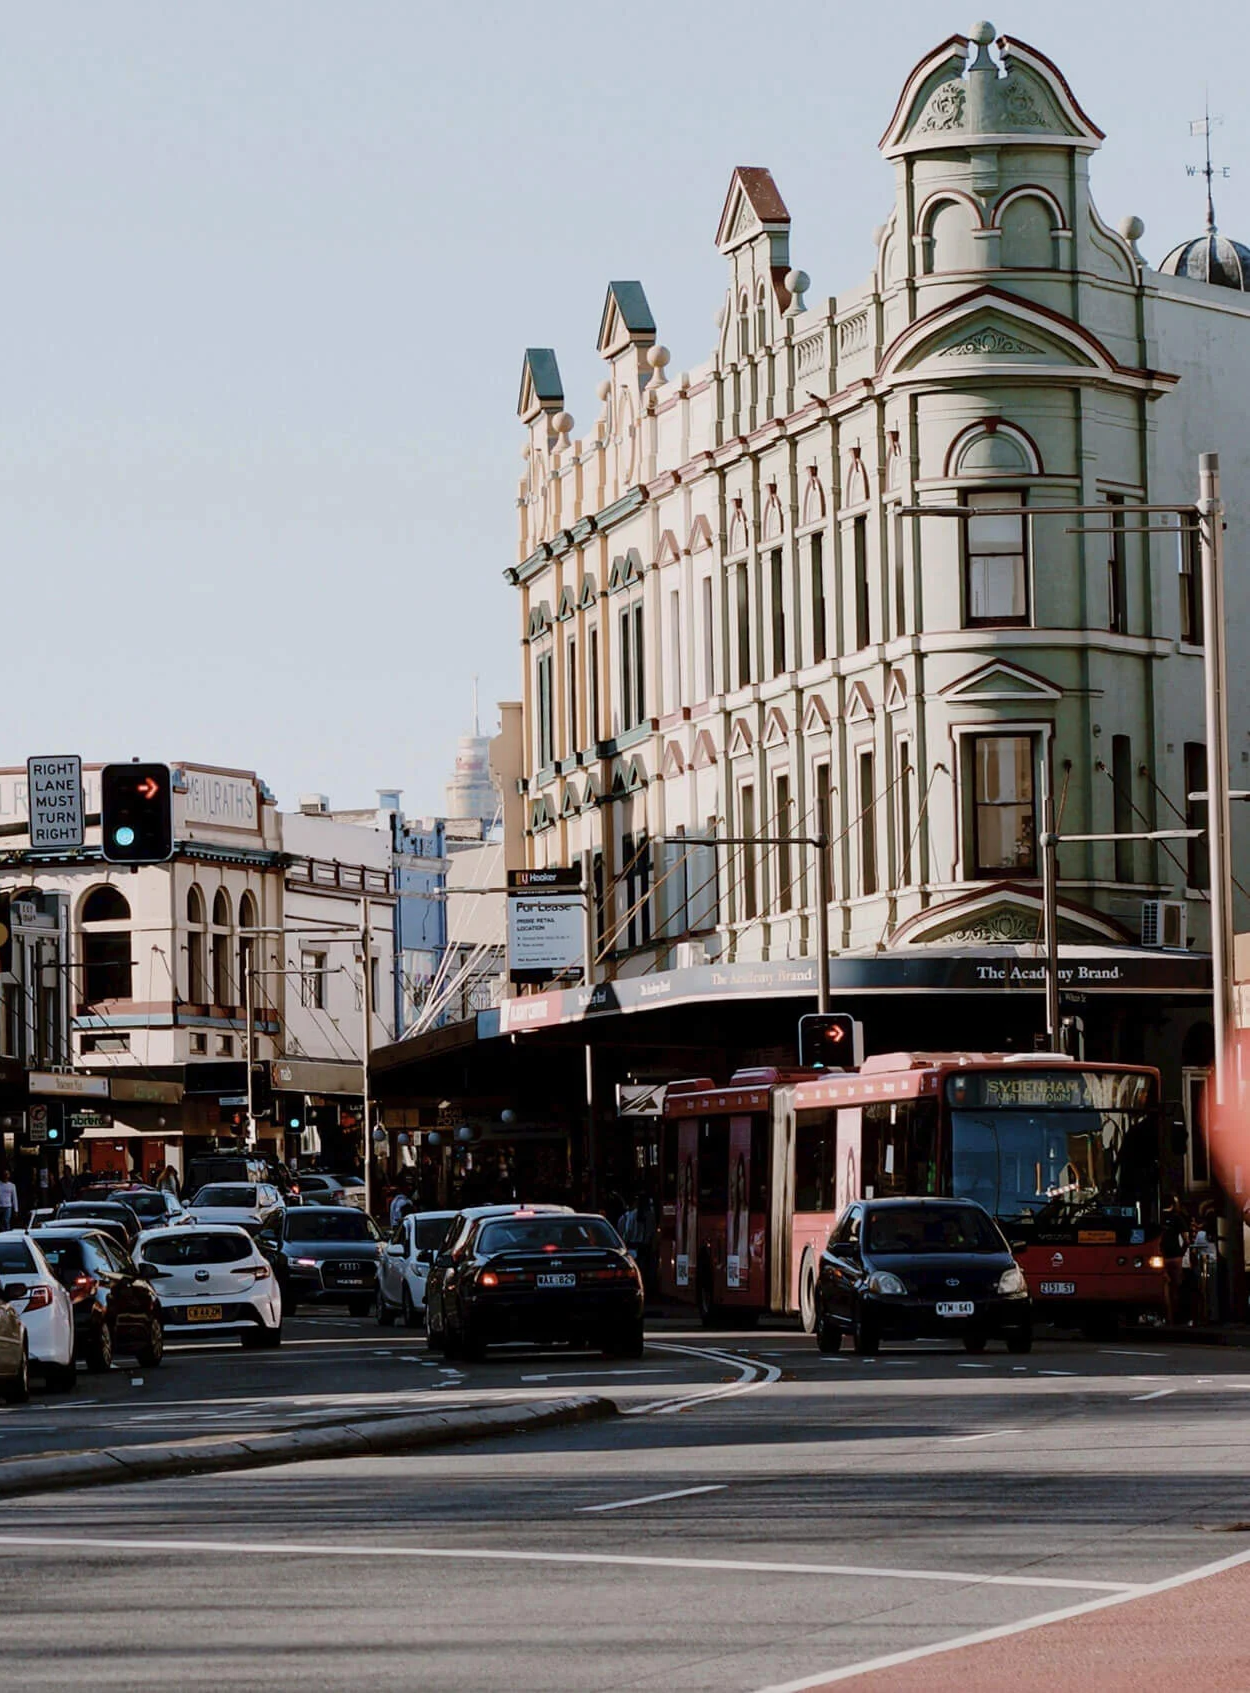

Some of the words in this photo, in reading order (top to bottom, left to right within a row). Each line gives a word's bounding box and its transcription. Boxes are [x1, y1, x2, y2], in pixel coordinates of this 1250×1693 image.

[33, 763, 75, 775] RIGHT
[36, 779, 75, 791] LANE
[36, 795, 75, 807] MUST
[38, 812, 76, 823] TURN
[36, 827, 78, 841] RIGHT
[530, 872, 557, 882] Hooker
[976, 966, 1006, 979] The
[1010, 966, 1074, 983] Acadmy
[1078, 966, 1119, 979] Brand
[988, 1080, 1079, 1093] SYDENHAM
[1018, 1092, 1071, 1101] NEWTOWN
